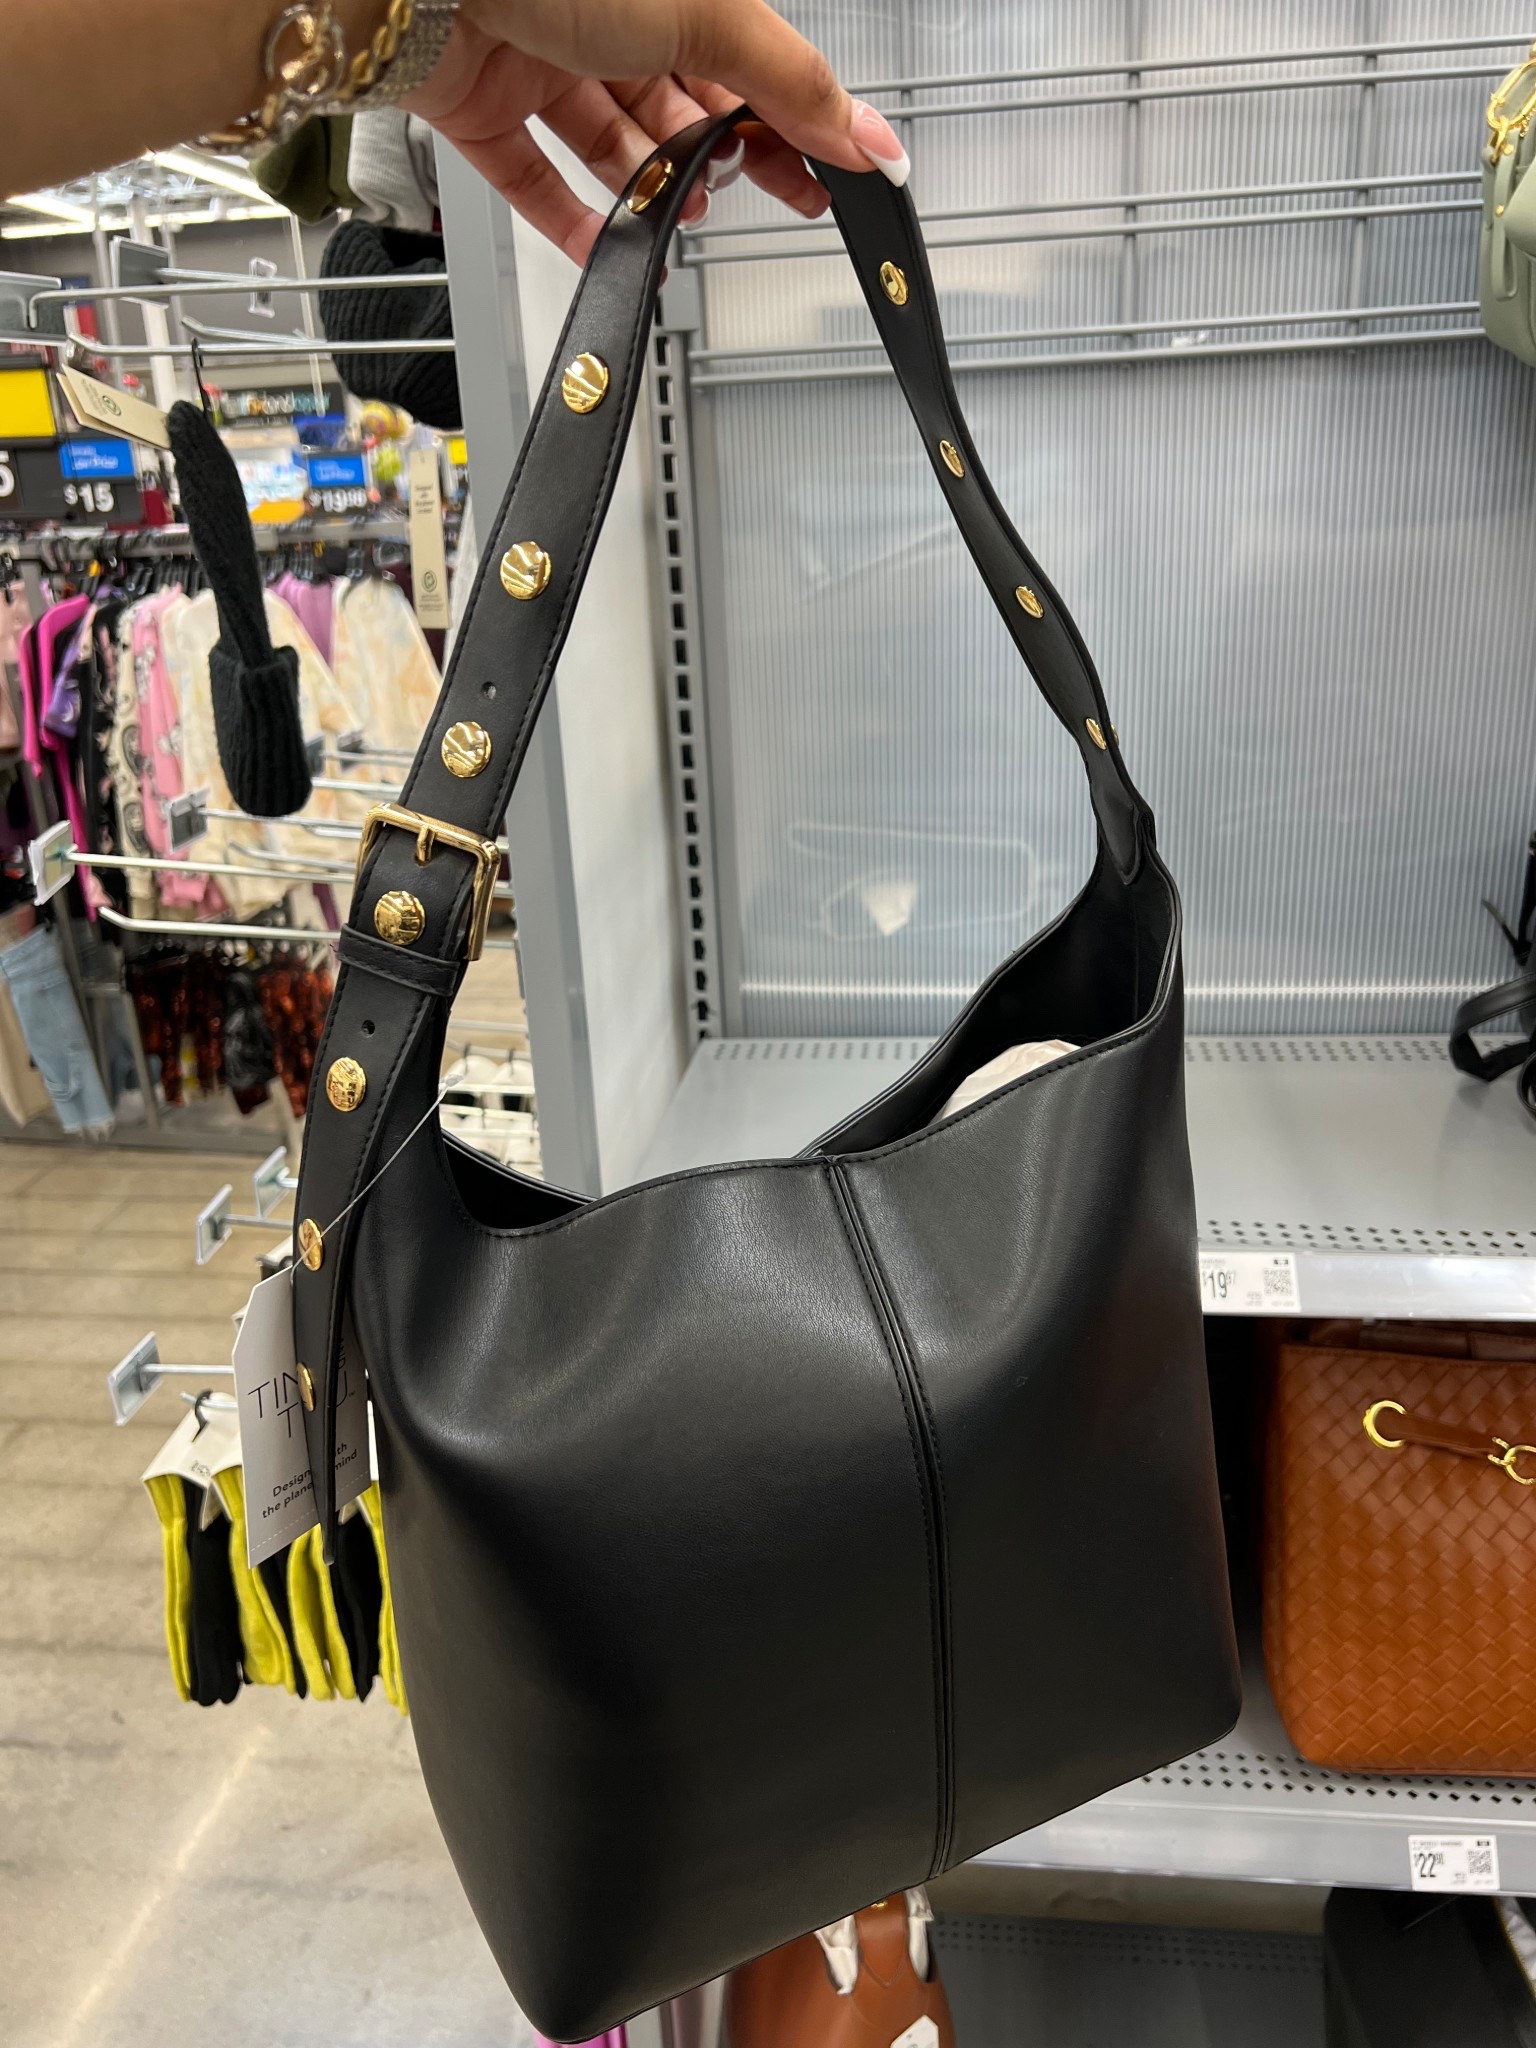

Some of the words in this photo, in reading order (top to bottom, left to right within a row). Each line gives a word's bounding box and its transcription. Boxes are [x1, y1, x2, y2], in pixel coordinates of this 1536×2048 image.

[63, 482, 114, 513] $15
[262, 1502, 281, 1519] the
[284, 1481, 314, 1507] plane
